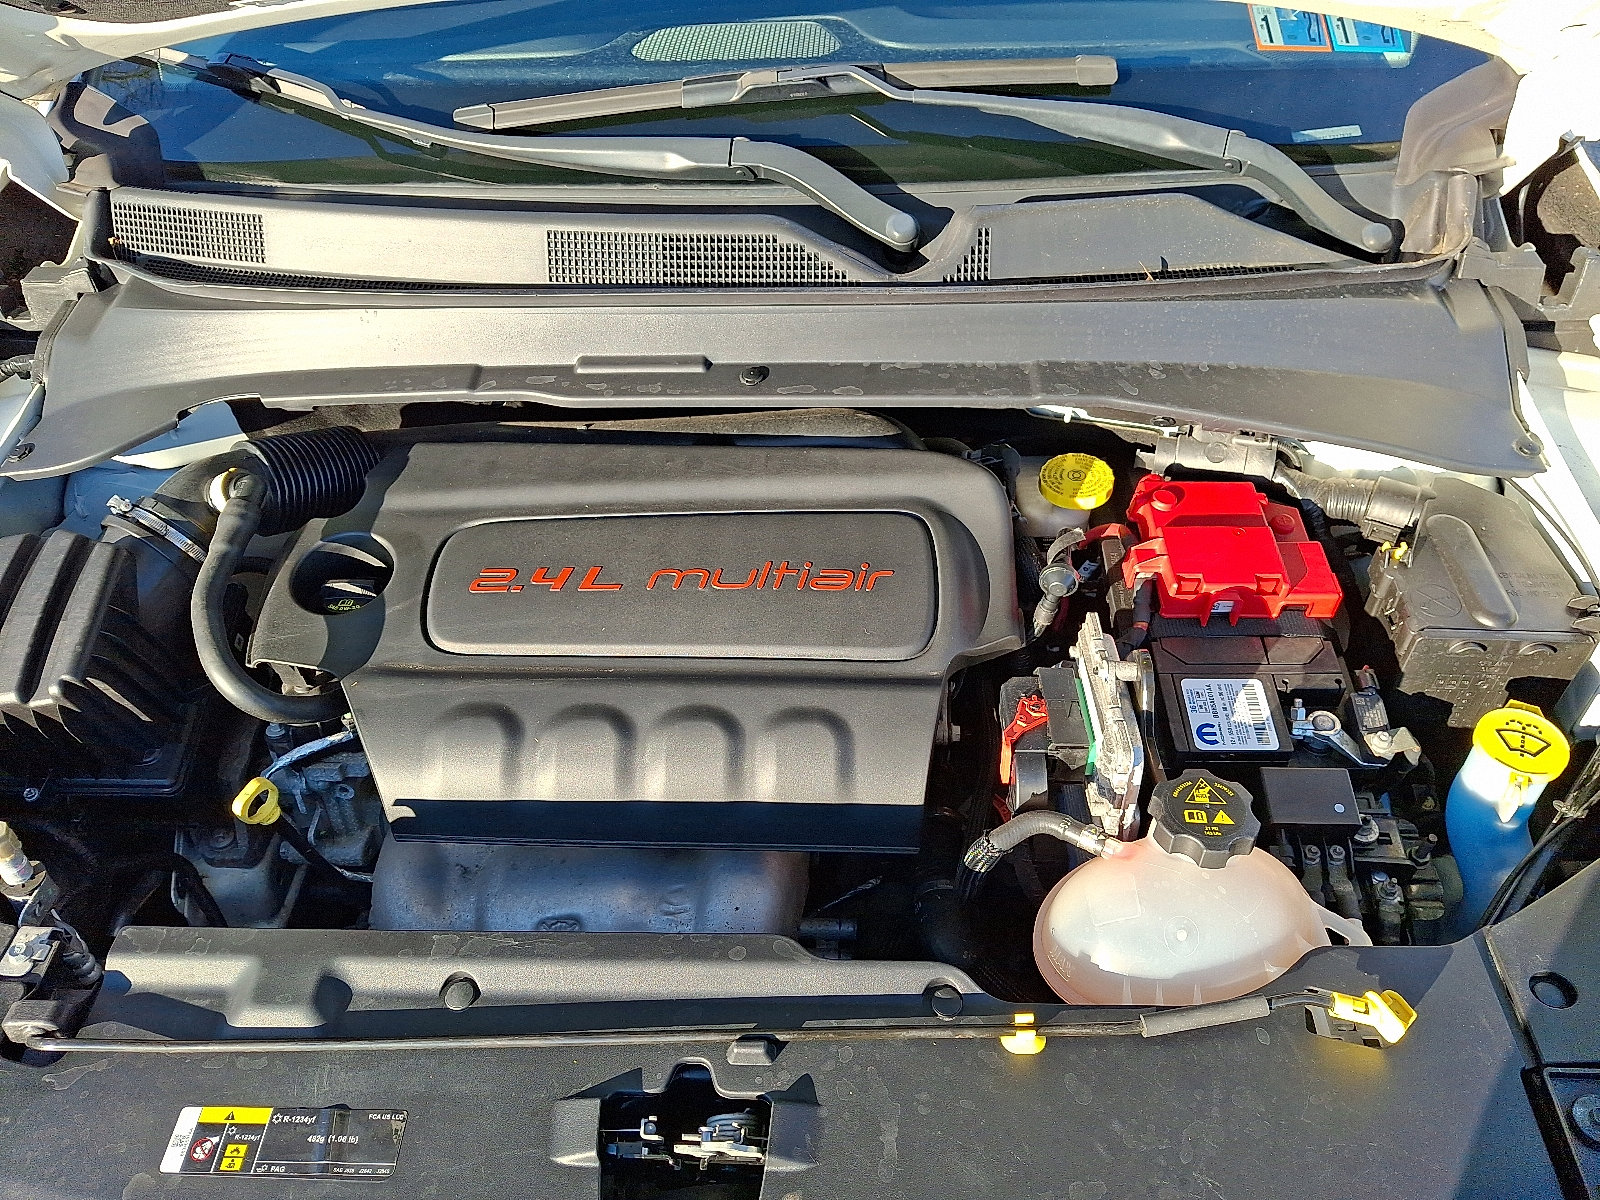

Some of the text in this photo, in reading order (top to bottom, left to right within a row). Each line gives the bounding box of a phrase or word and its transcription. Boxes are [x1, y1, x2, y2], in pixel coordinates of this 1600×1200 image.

[1261, 15, 1274, 43] 1
[468, 560, 896, 592] 2.4L multiair
[283, 1115, 316, 1124] R-1234yf
[234, 1133, 261, 1142] R-1234yf
[270, 1165, 286, 1173] PAG
